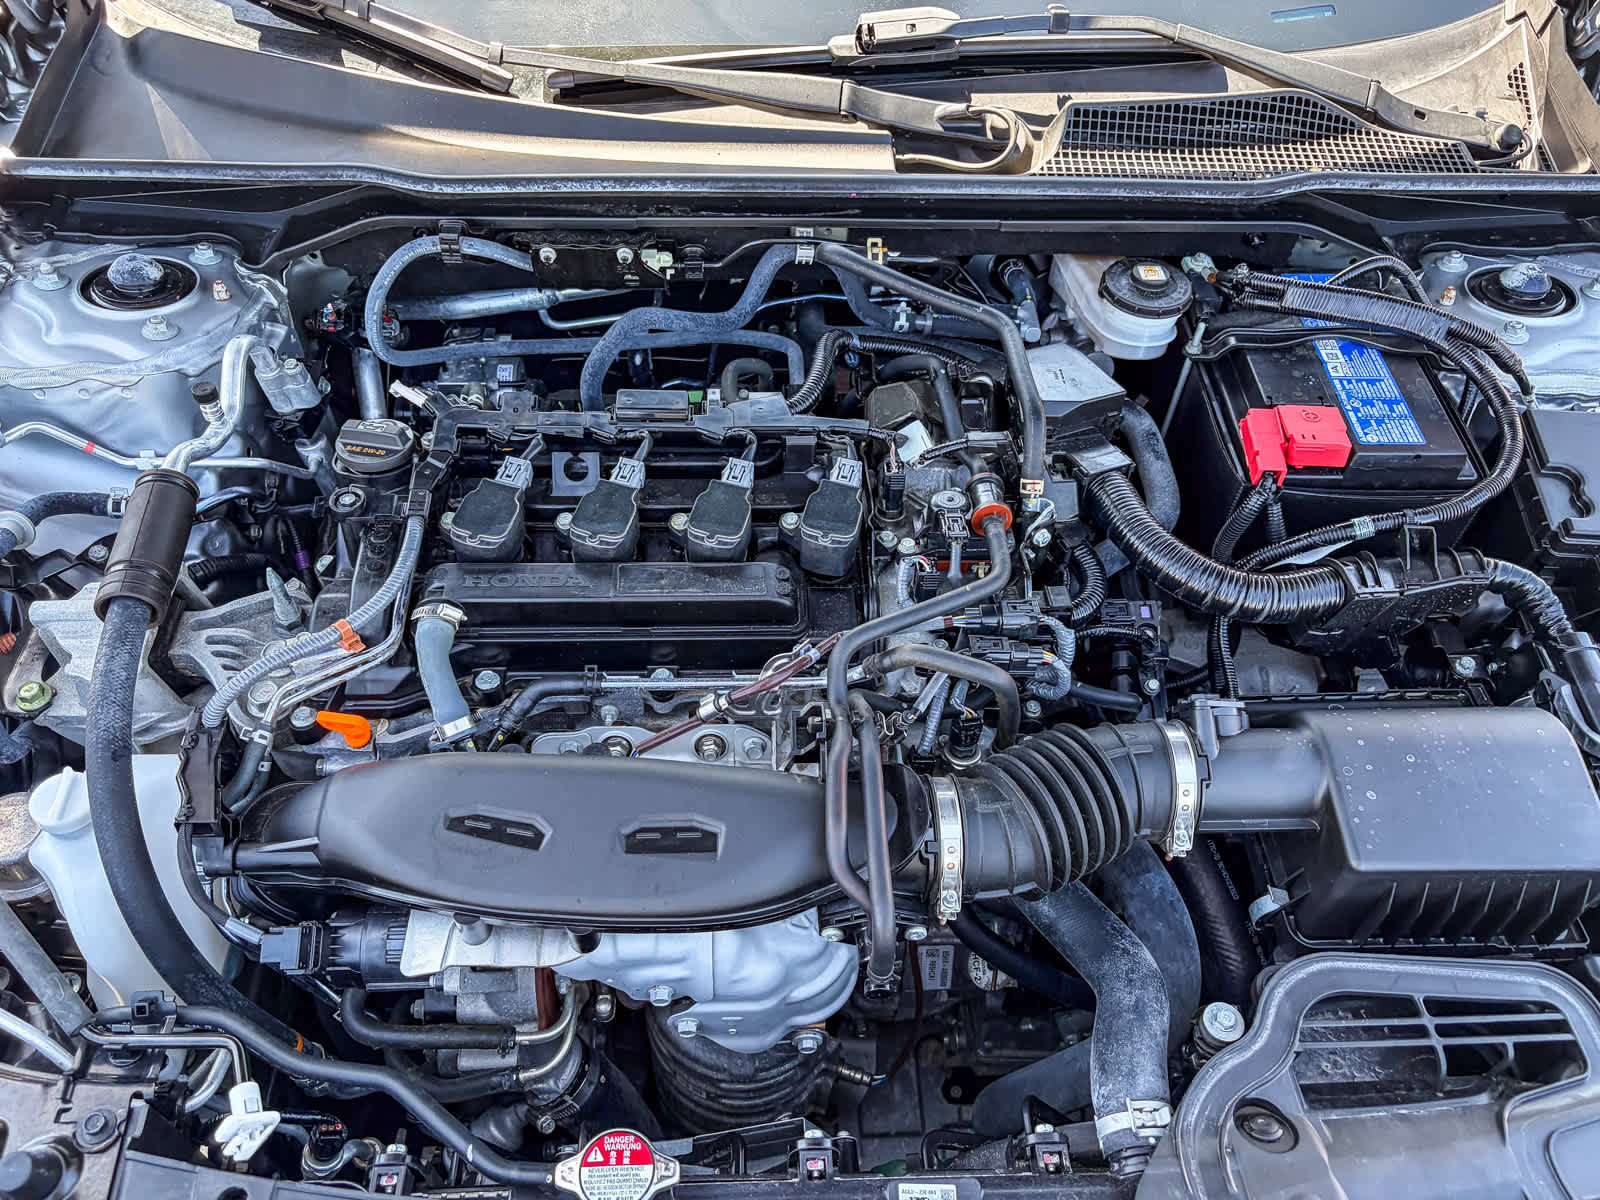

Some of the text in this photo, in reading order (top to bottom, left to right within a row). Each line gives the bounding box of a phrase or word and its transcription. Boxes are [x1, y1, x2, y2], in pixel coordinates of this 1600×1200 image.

[363, 448, 387, 456] 0W-20
[463, 573, 592, 588] HONDA
[604, 1136, 635, 1144] DANGER
[604, 1143, 642, 1151] WARNUNG
